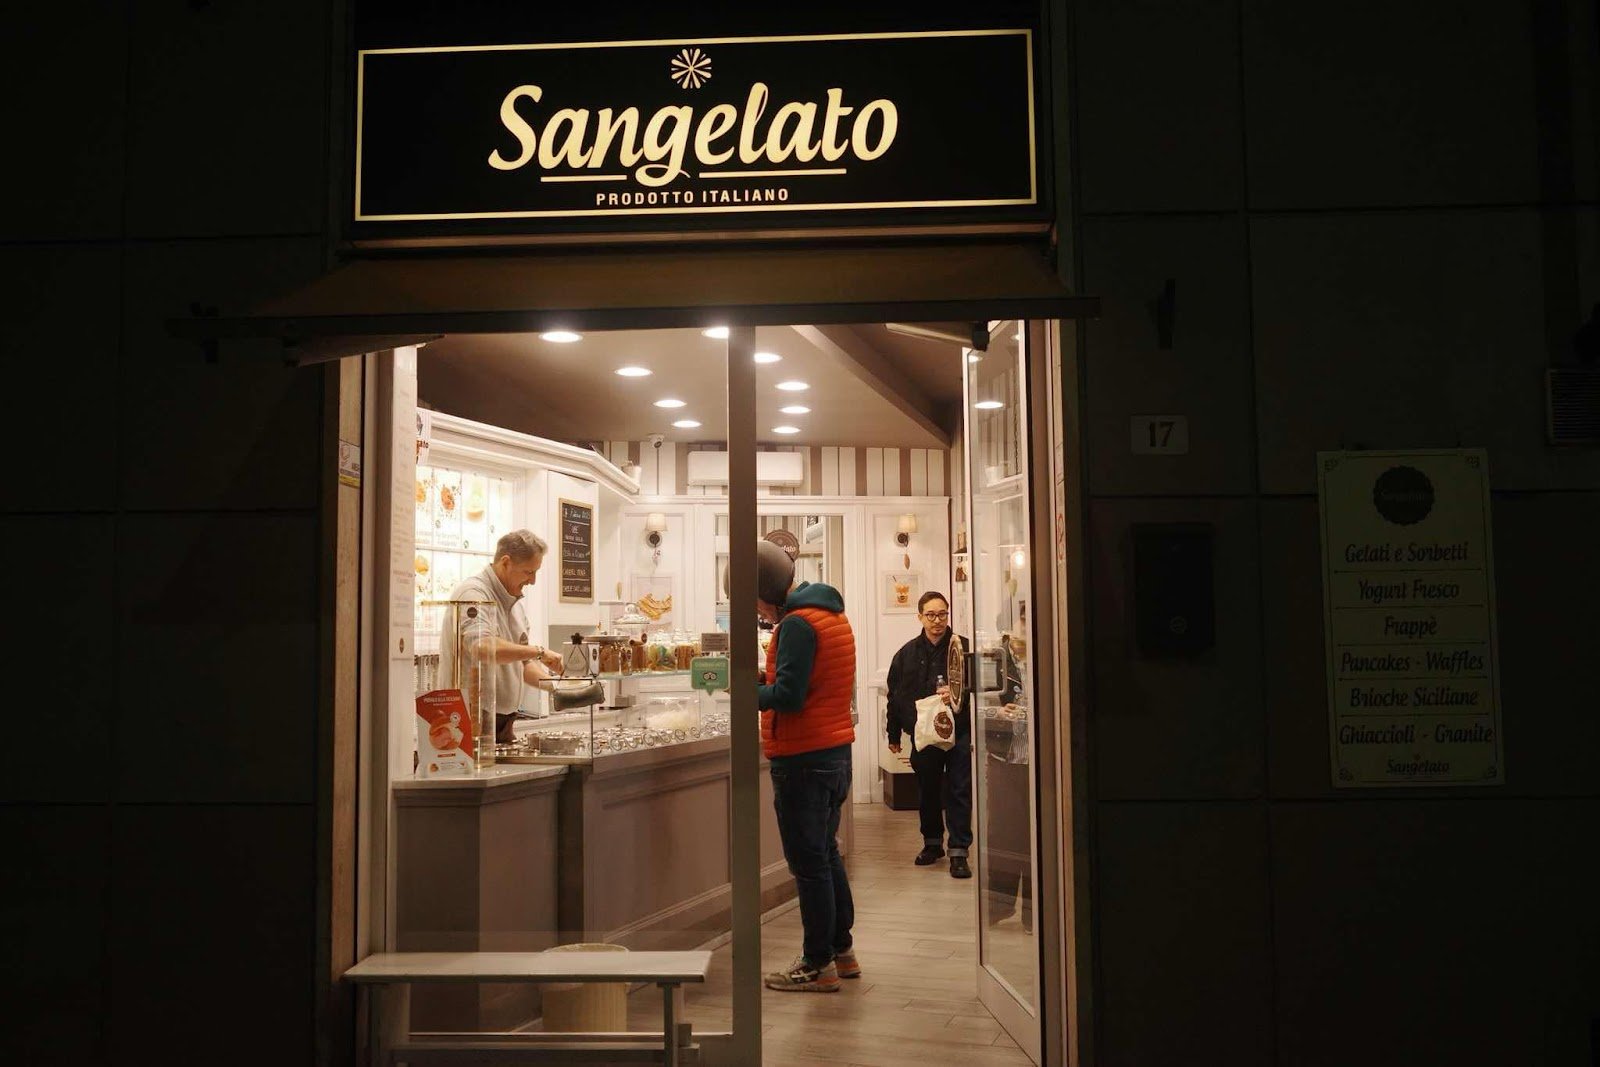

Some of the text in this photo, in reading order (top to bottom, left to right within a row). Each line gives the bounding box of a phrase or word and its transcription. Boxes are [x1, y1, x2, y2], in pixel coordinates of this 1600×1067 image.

[488, 82, 898, 187] Sangelato
[596, 188, 789, 206] PRODOTTO ITALIANO
[1149, 421, 1176, 447] 17
[1345, 541, 1469, 563] Gelati e Sorbetti
[1358, 578, 1460, 603] Yogurt Fresco
[1384, 616, 1438, 638] Frappè
[1341, 652, 1411, 672] Pancakes
[1426, 650, 1484, 674] Waffles
[1350, 687, 1479, 707] Brioche Siciliane
[1339, 724, 1415, 744] Ghiaccioli
[1435, 723, 1493, 743] Granite
[1386, 759, 1450, 775] Sangelato
